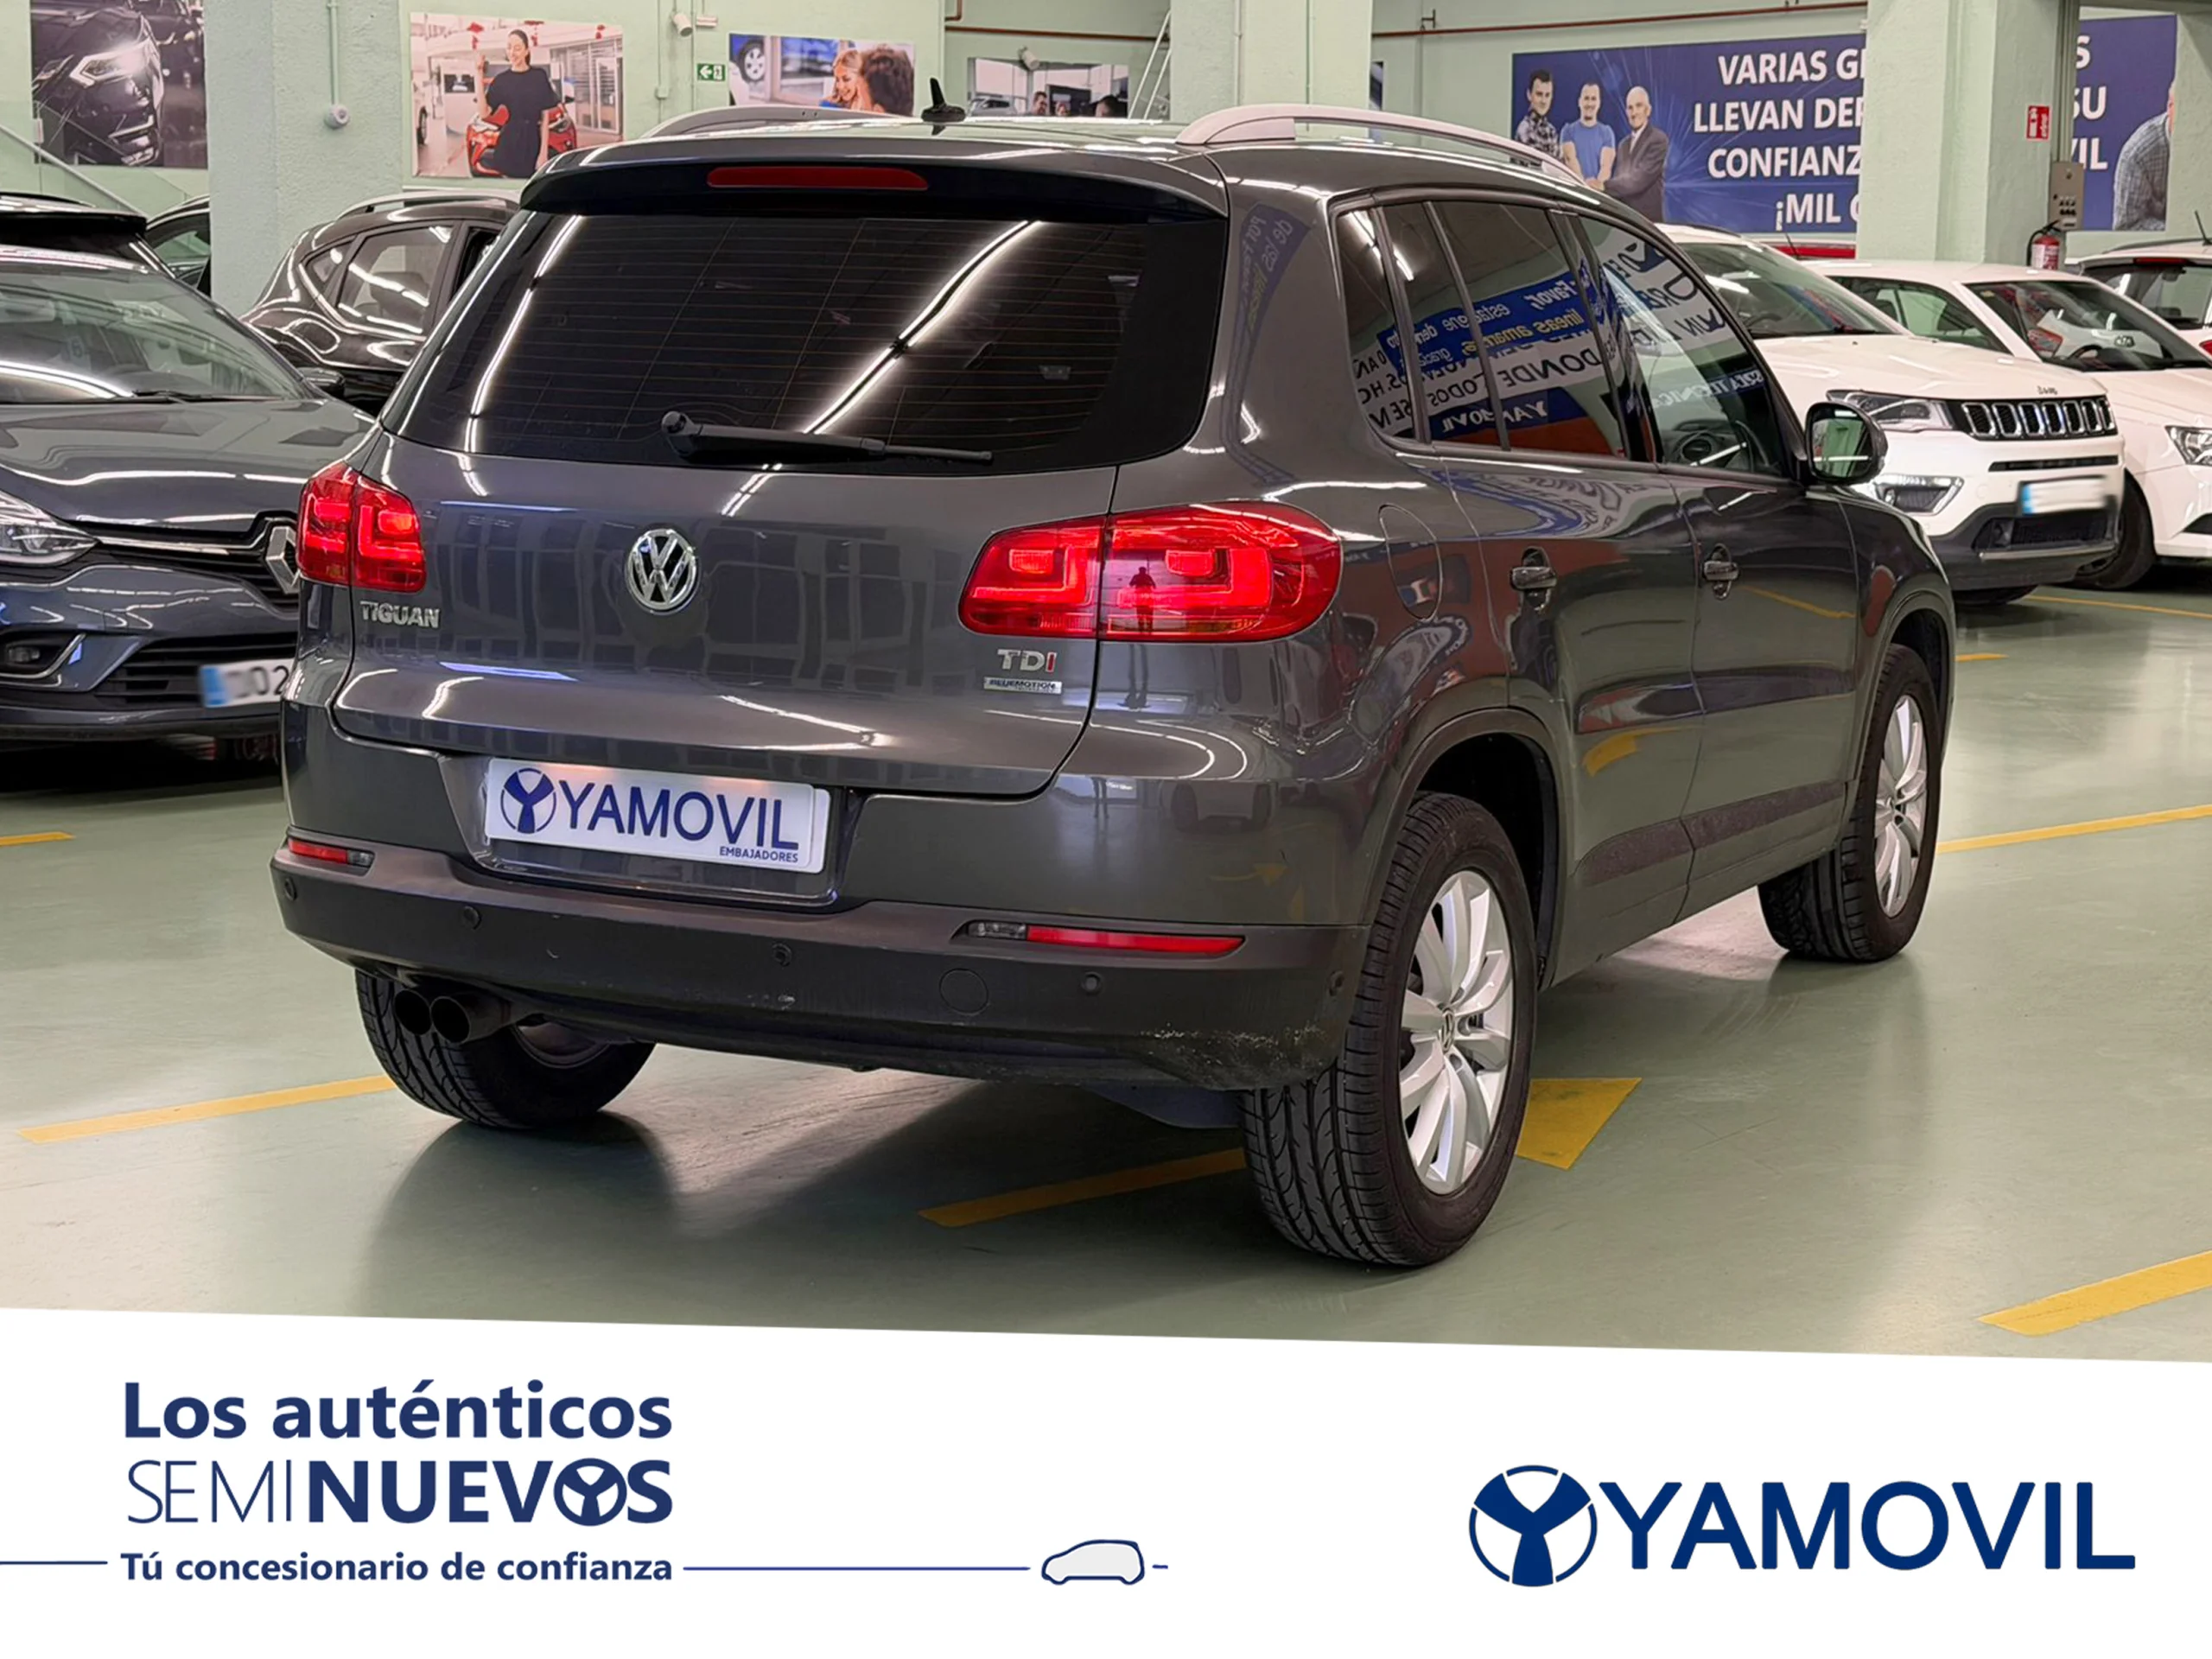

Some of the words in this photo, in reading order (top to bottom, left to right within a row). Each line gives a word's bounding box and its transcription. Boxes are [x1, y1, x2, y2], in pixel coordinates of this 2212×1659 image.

[1718, 49, 1827, 85] VARIAS
[1694, 99, 1803, 132] LLEVAN
[1776, 193, 1841, 231] ¡MIL
[359, 601, 440, 628] TIGUAN
[997, 649, 1058, 672] TDI
[559, 779, 799, 850] YAMOVIL
[719, 846, 799, 863] EMBAJADORES
